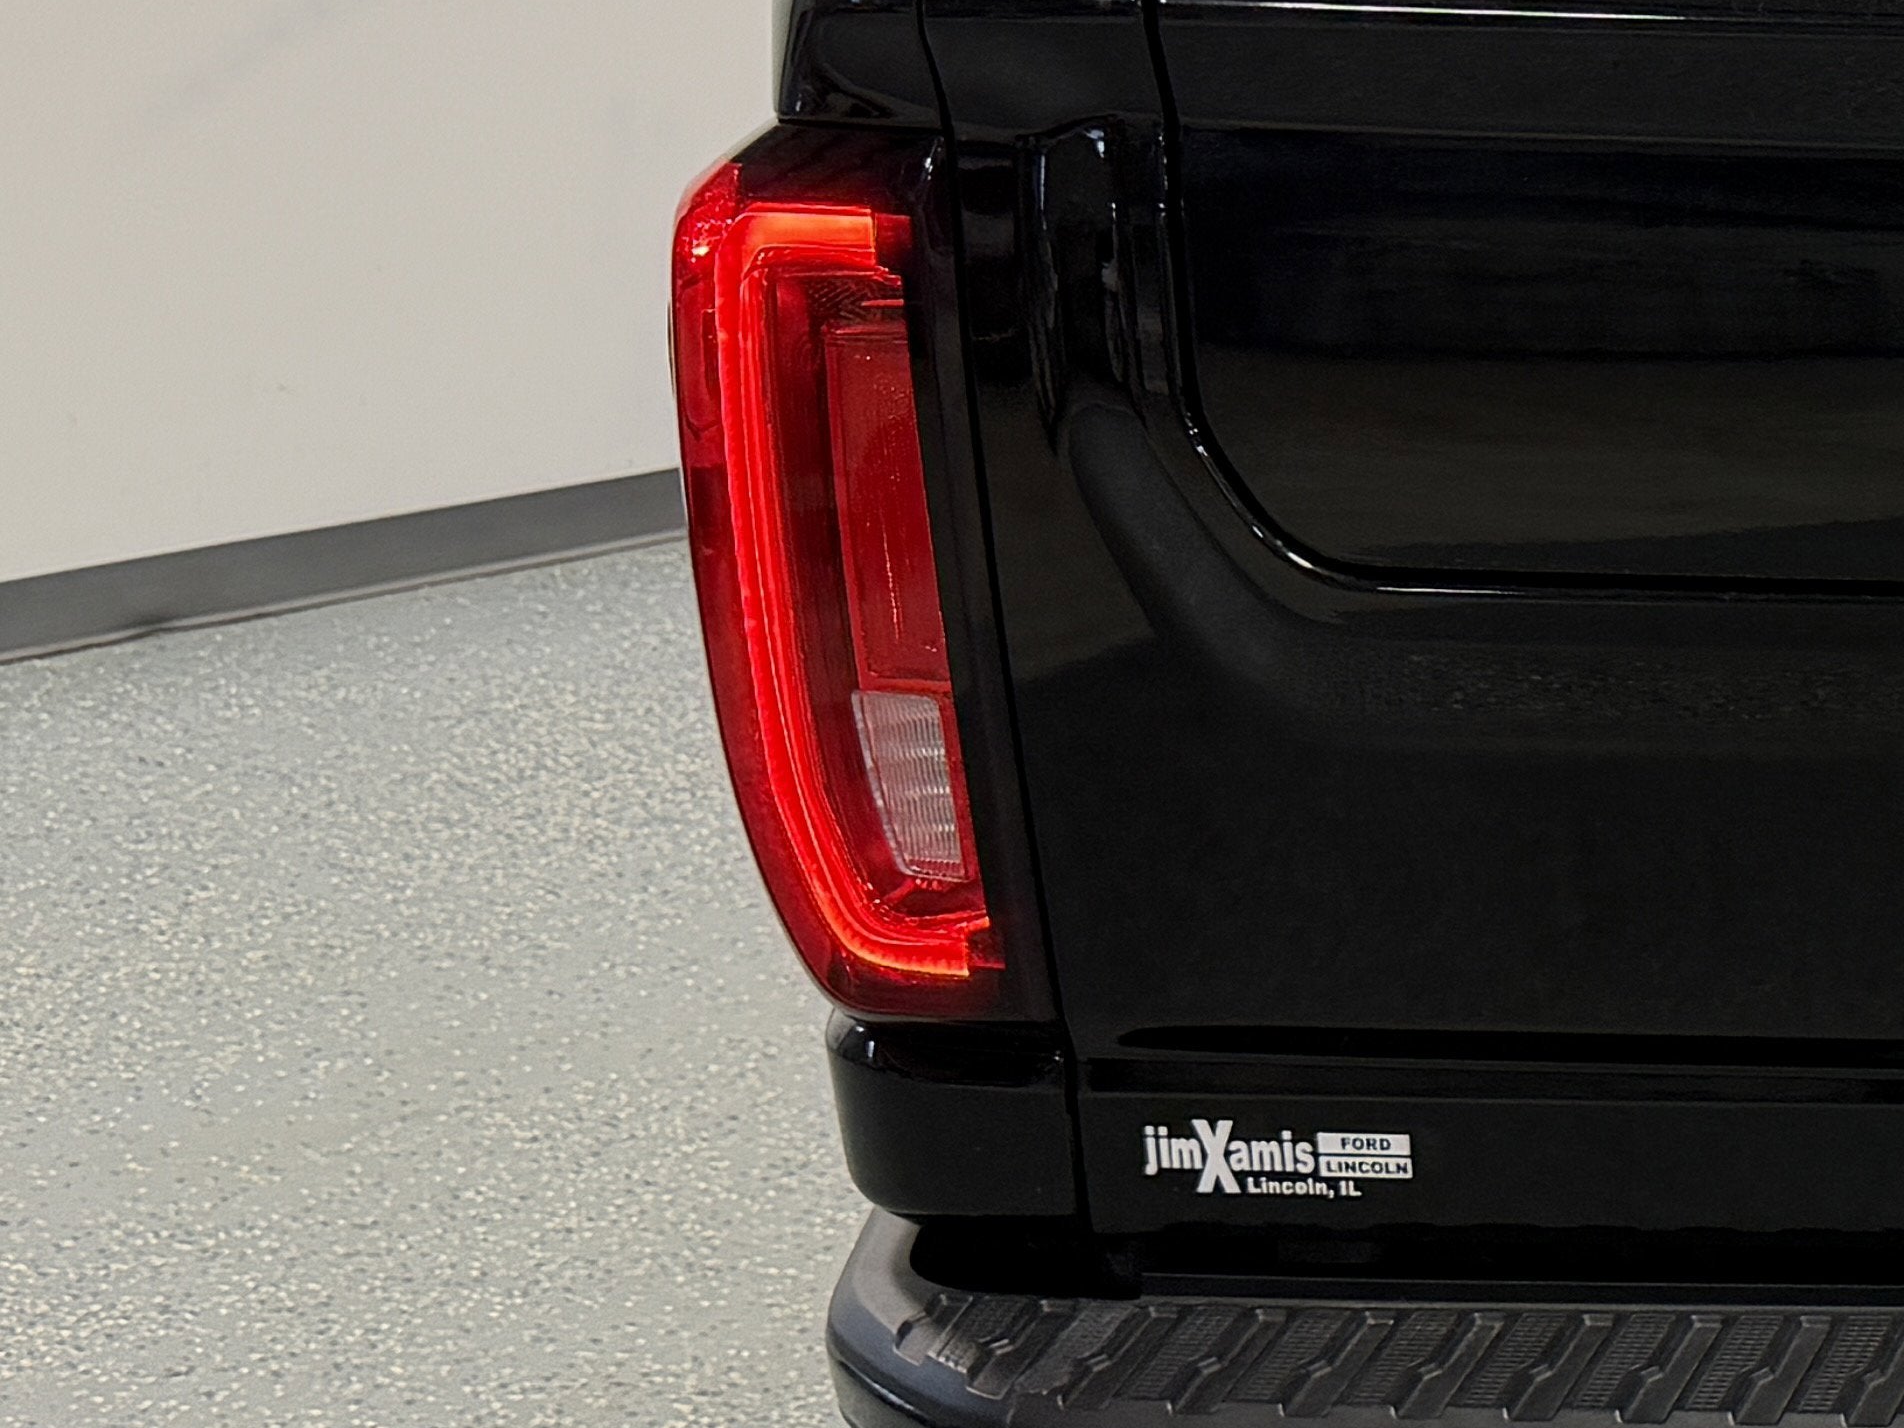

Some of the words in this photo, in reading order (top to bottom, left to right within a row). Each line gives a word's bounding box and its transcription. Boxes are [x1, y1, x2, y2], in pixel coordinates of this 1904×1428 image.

[1340, 1137, 1392, 1151] FORD
[1326, 1159, 1409, 1175] LINCOLN
[1246, 1176, 1335, 1199] Lincoln,
[1339, 1180, 1363, 1197] IL
